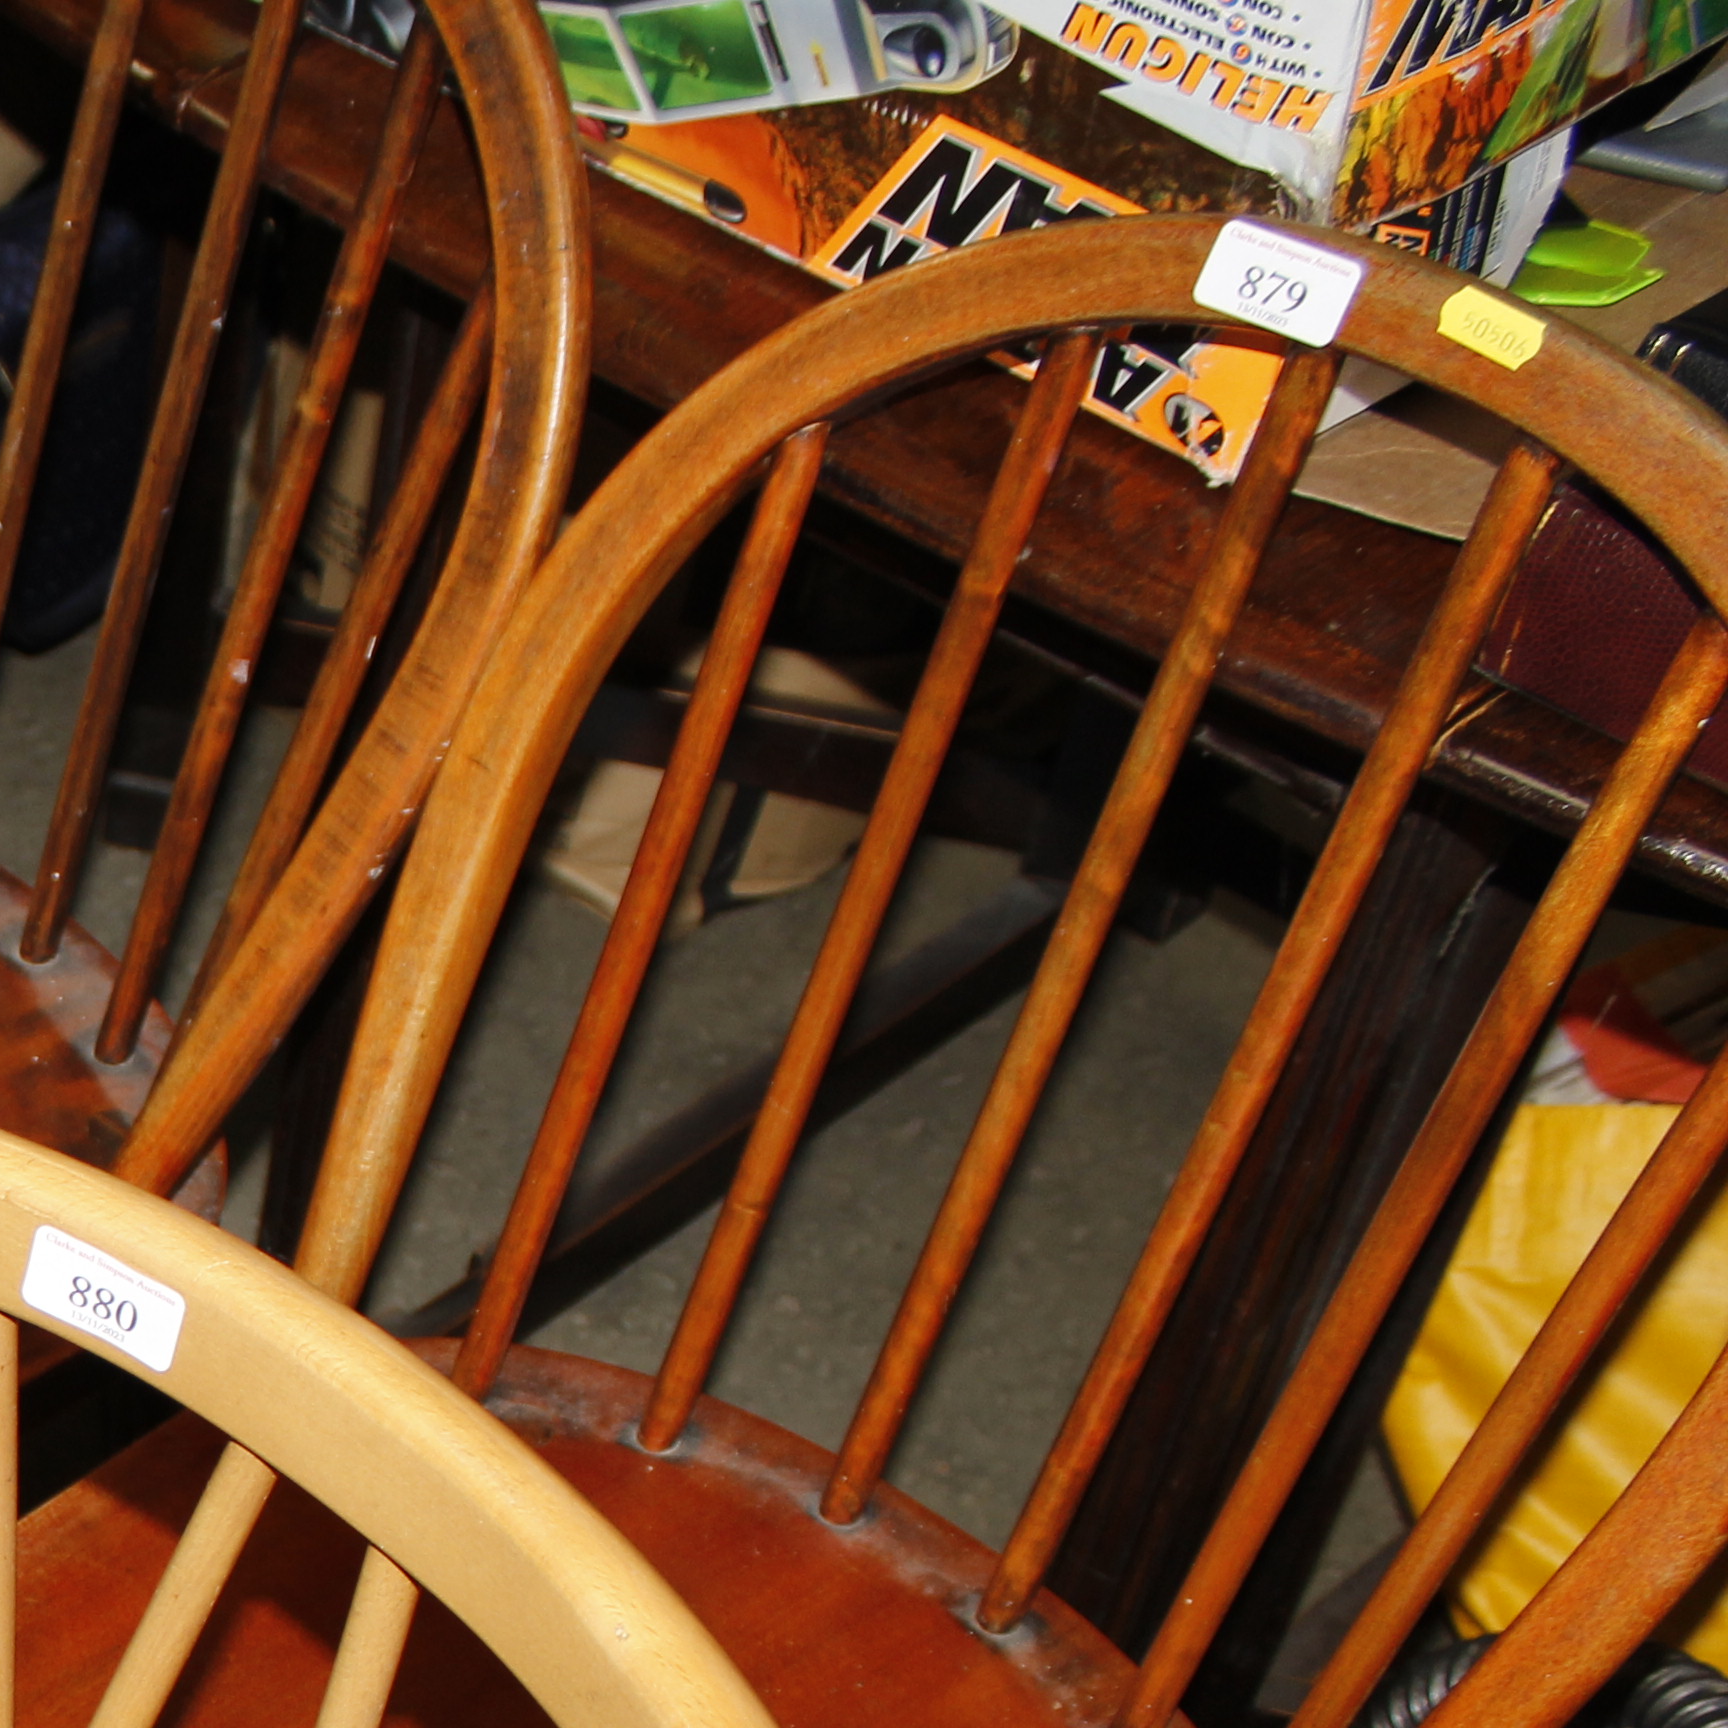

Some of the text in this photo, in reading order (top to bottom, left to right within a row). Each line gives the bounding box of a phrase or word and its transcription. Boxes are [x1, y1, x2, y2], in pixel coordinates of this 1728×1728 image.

[1251, 25, 1296, 50] CON
[1058, 2, 1335, 134] HELIGUN
[1237, 265, 1308, 312] 879
[1461, 310, 1528, 359] 50506
[45, 1232, 177, 1307] Clarke and Simpson Auctions
[68, 1275, 138, 1332] 880
[71, 1309, 126, 1344] 13/11/2023
